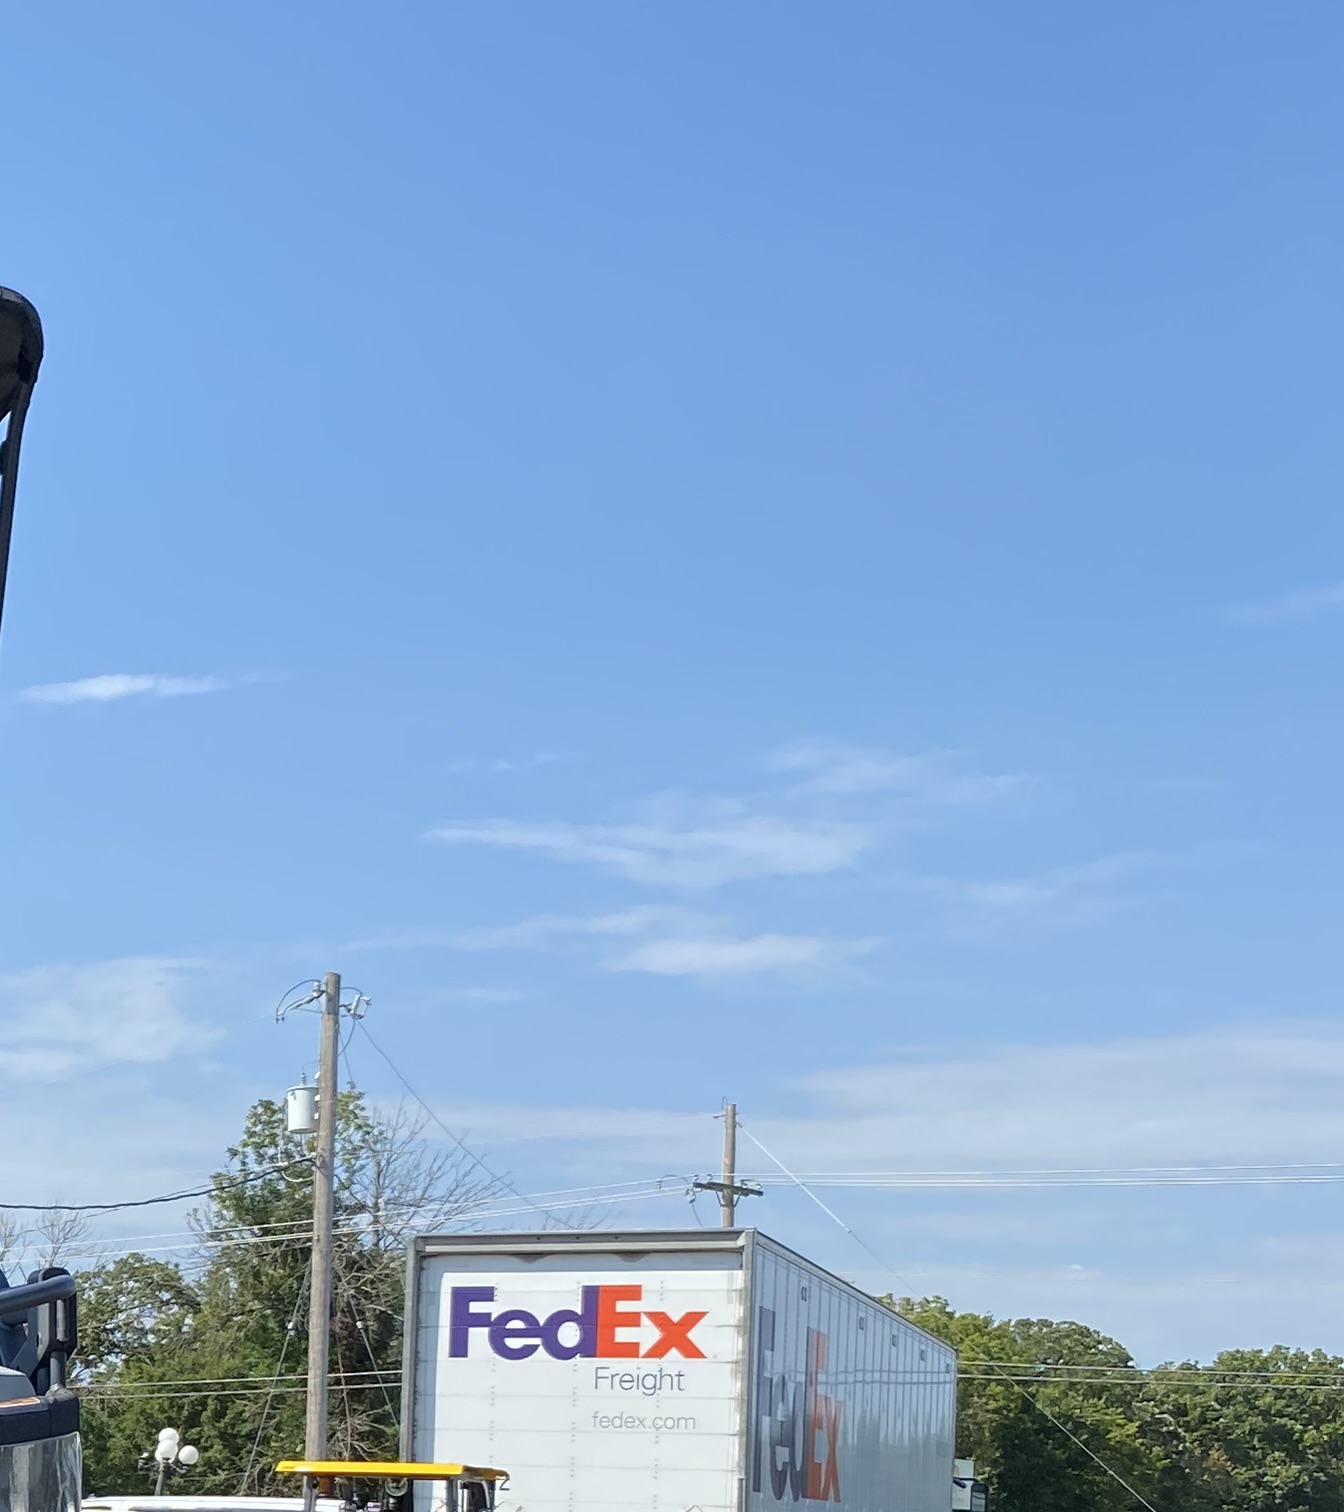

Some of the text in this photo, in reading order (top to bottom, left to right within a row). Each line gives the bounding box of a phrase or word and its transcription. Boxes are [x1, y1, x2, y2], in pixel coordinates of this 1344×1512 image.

[448, 1284, 709, 1361] FedEx
[594, 1366, 685, 1396] Freight
[752, 1305, 842, 1503] FedEx
[592, 1411, 696, 1431] fedex.com
